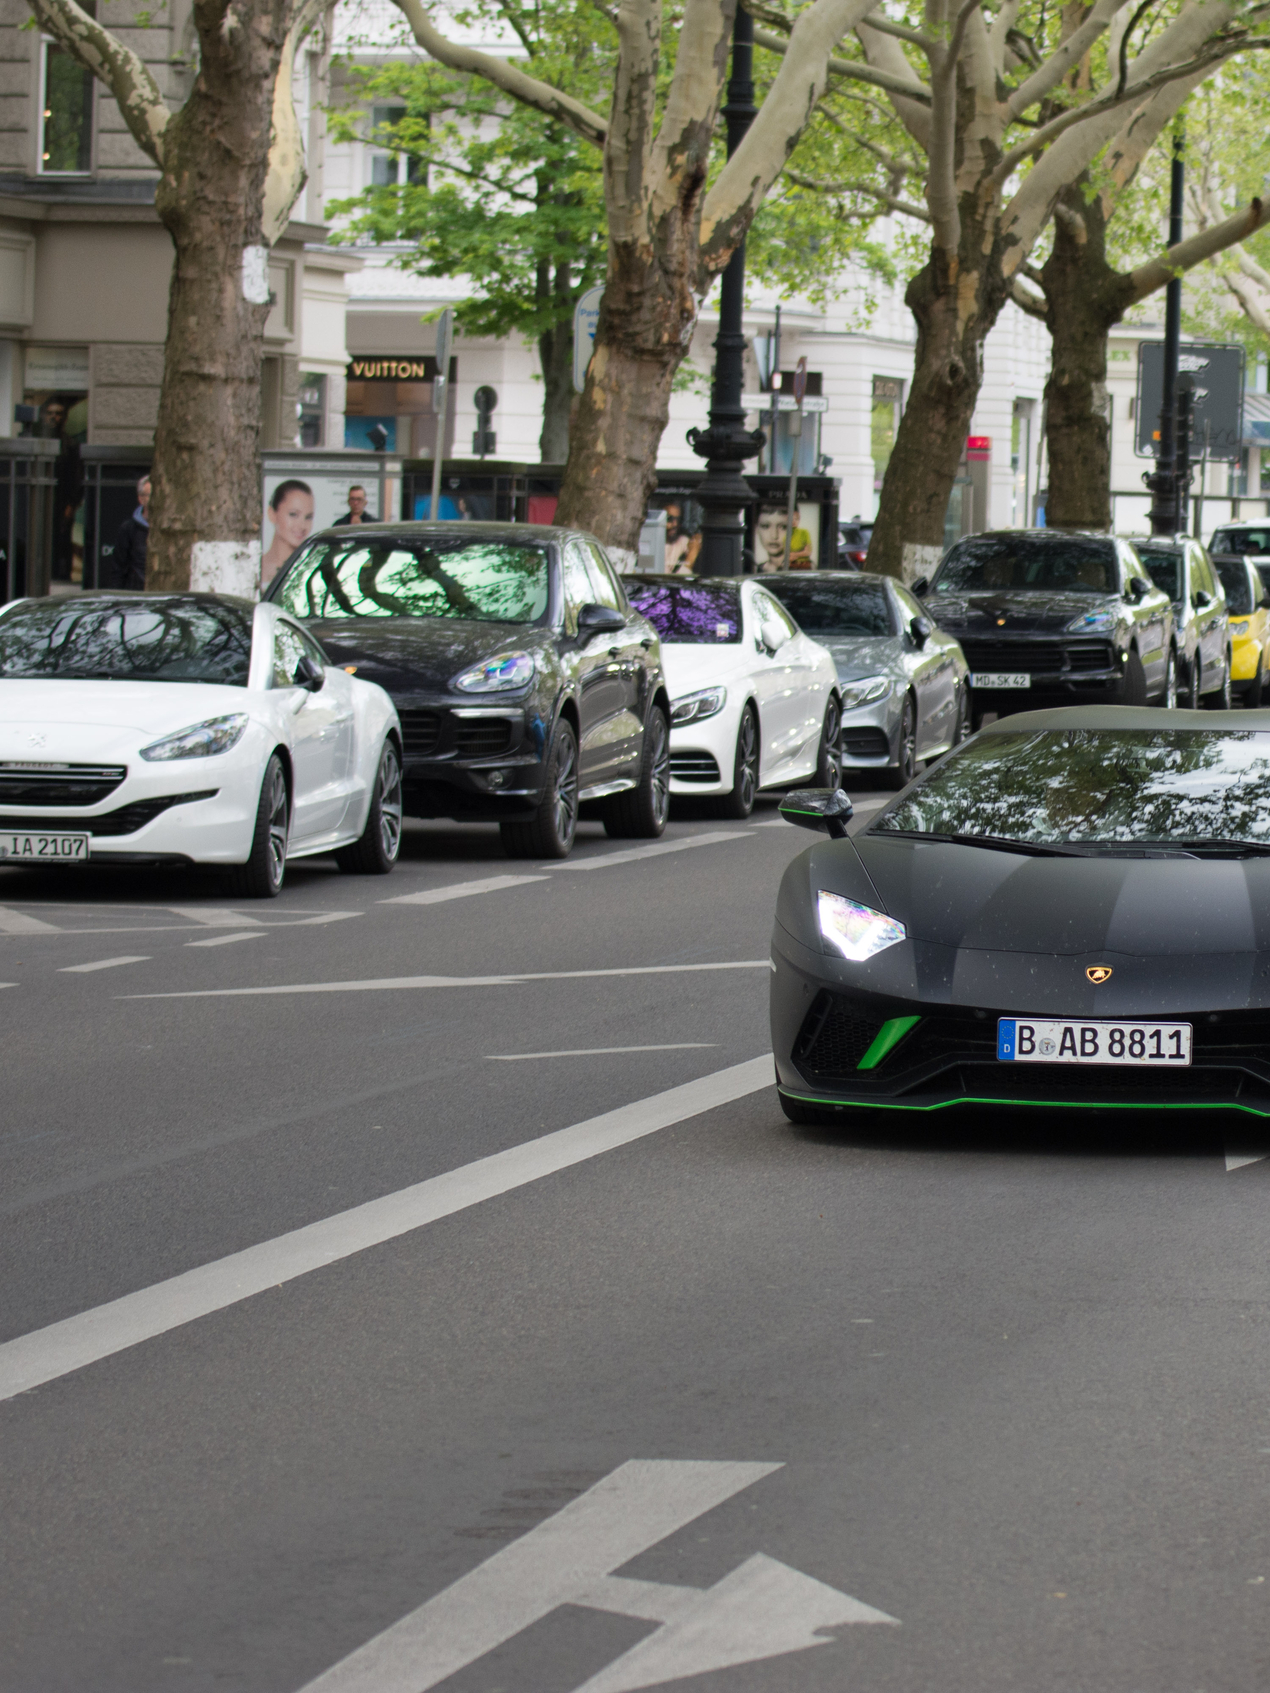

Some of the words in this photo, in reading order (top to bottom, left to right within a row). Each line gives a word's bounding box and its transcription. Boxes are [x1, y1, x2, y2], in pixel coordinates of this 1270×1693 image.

[352, 361, 425, 378] VUITTON
[975, 675, 990, 686] MD
[997, 675, 1011, 686] SK
[1013, 675, 1027, 686] 42
[11, 836, 34, 856] IA
[37, 837, 84, 857] 2107
[1003, 1043, 1011, 1053] D
[1018, 1025, 1037, 1055] B
[1058, 1026, 1100, 1057] AB
[1108, 1028, 1186, 1060] 8811
